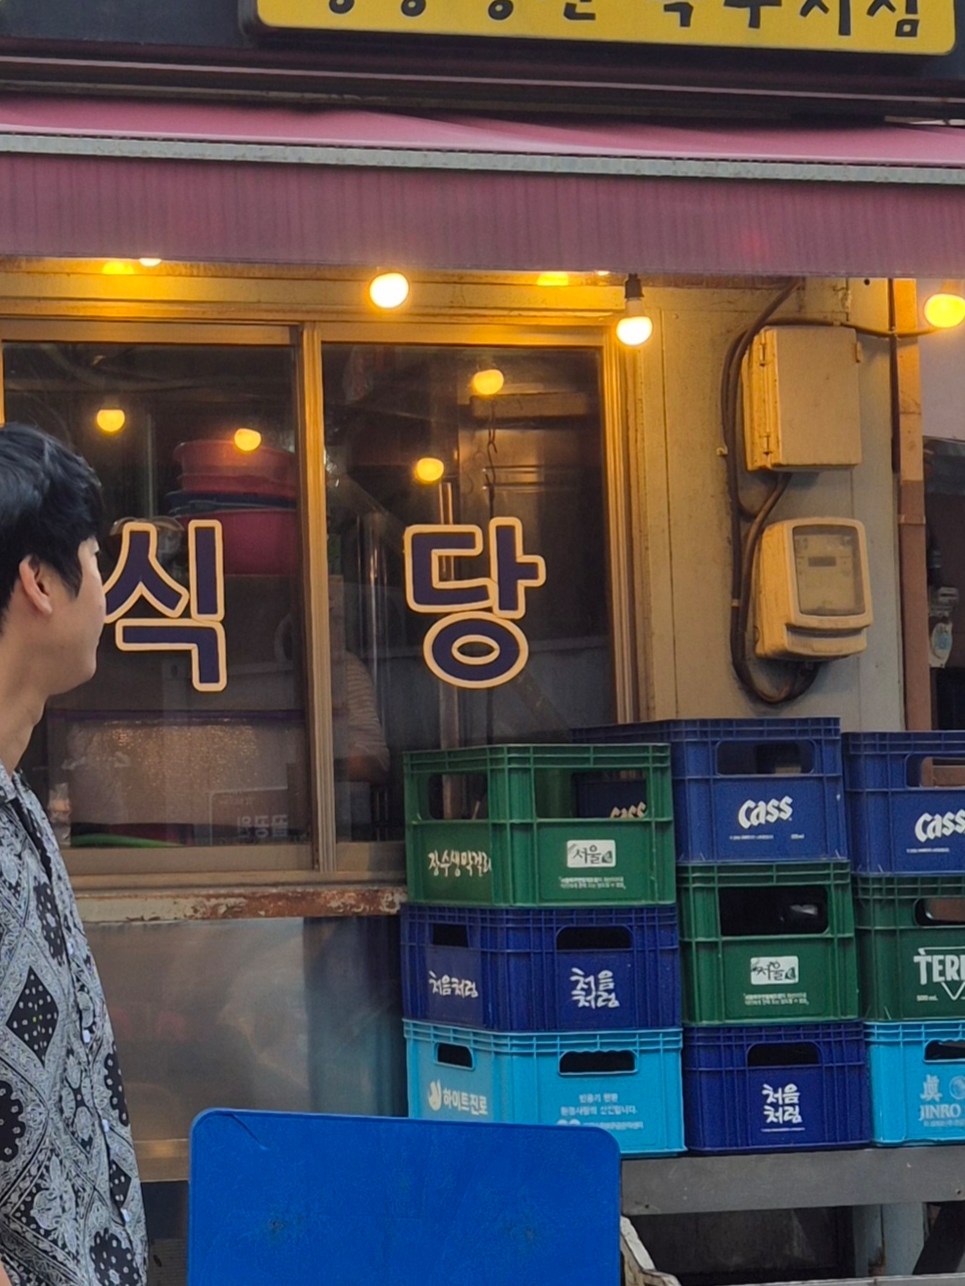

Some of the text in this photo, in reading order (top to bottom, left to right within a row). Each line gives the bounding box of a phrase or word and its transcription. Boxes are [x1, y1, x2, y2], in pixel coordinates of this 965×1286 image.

[738, 796, 793, 829] Cass
[915, 809, 965, 843] Cass
[573, 844, 602, 864] 서울
[570, 967, 615, 992] 처음
[913, 954, 965, 985] TER
[429, 970, 478, 998] 처음처럼
[571, 990, 620, 1009] 처럼
[443, 1087, 488, 1115] 하이트진로
[762, 1083, 800, 1105] 처음
[763, 1105, 803, 1124] 처럼
[919, 1103, 962, 1121] JINRO
